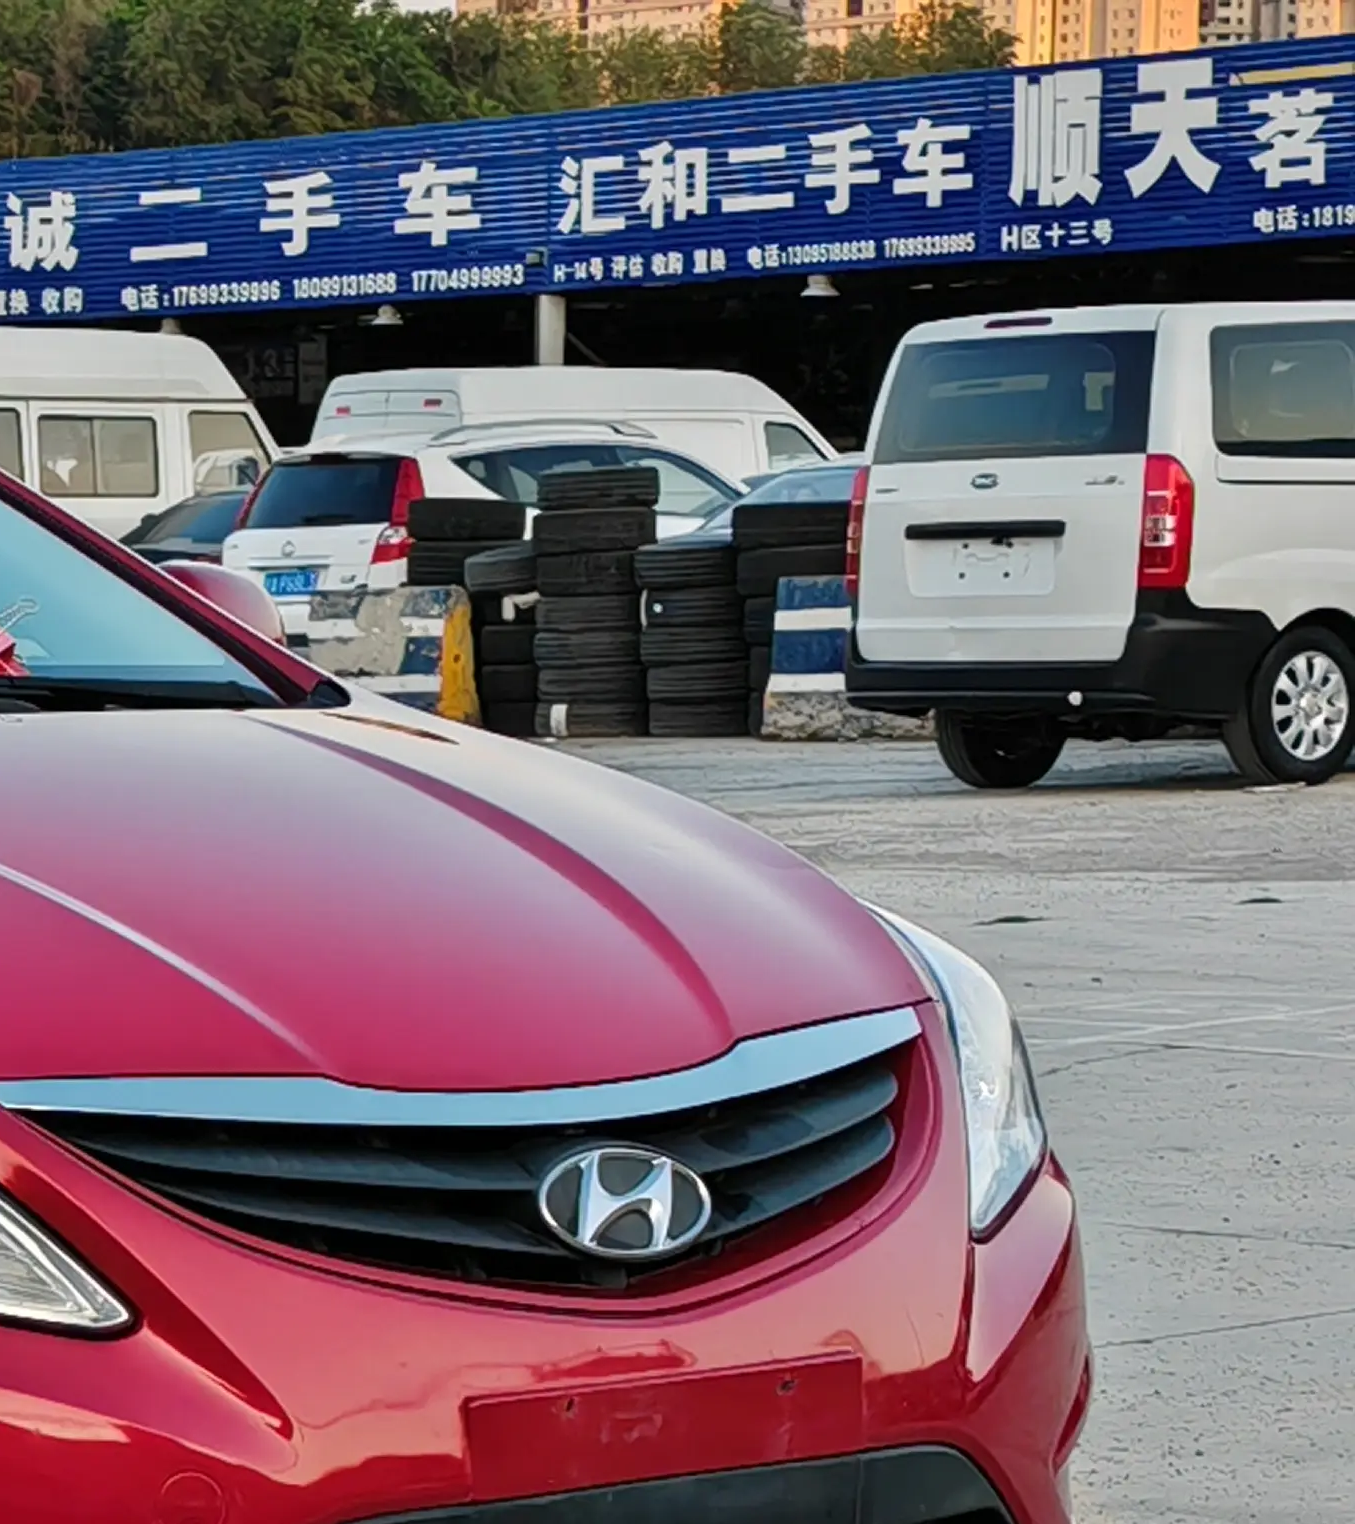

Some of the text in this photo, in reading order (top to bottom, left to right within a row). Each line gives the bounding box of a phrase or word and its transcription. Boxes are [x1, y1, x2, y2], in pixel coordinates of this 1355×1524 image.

[1008, 57, 1334, 207] 顺天 茗
[557, 117, 976, 235] 汇和二手车
[1000, 219, 1112, 251] H区十三号
[41, 287, 83, 314] 收购
